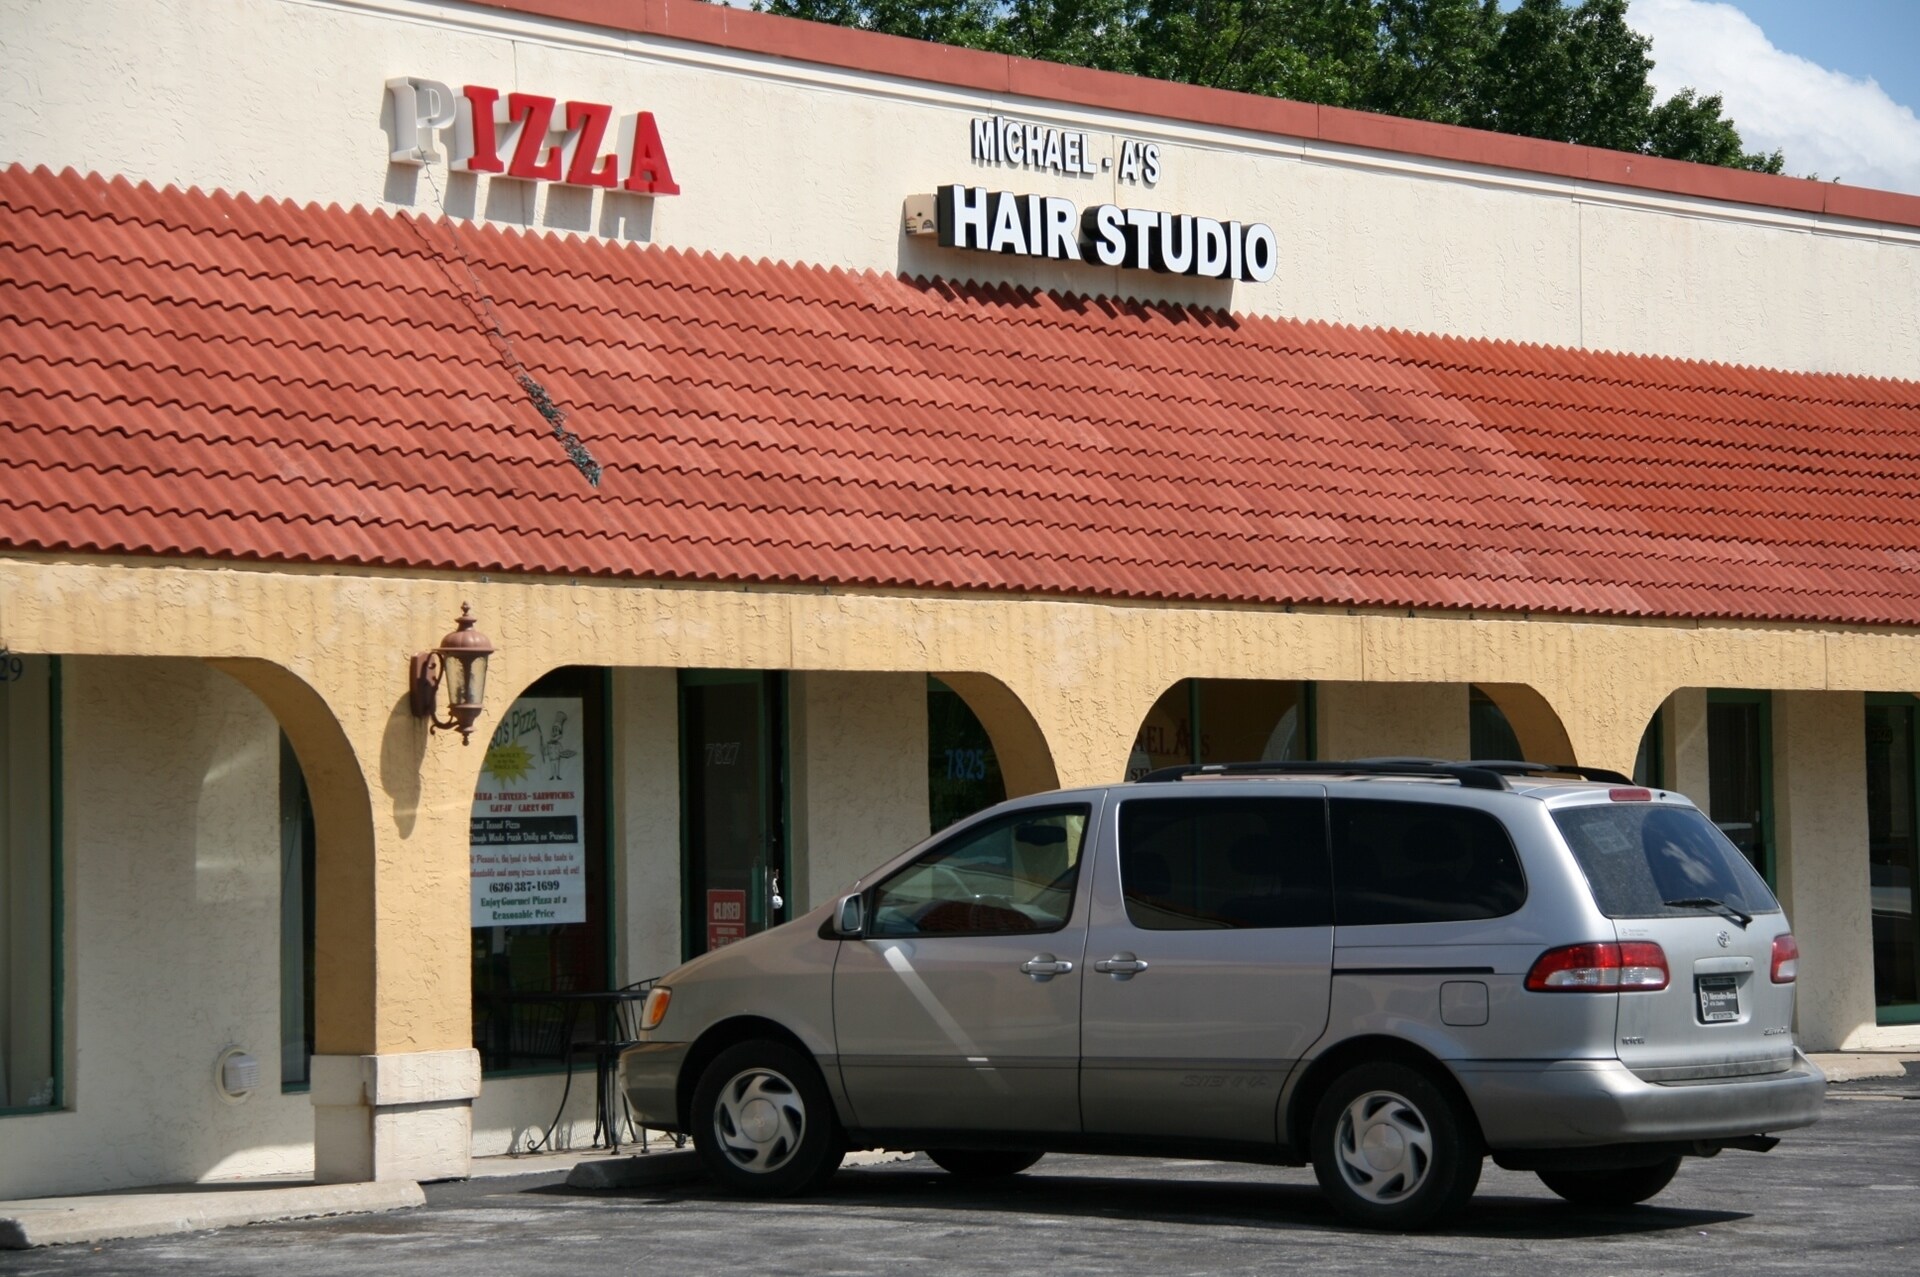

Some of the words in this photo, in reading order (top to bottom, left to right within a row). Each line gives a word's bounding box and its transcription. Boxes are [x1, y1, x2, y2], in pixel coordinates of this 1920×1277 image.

[385, 76, 680, 196] PIZZA
[971, 115, 1097, 174] MICHAEL
[1119, 140, 1162, 185] A'S
[950, 184, 1082, 261] HAIR
[1094, 203, 1278, 283] STUDIO
[944, 748, 986, 781] 7825
[532, 791, 575, 801] SANDWICHES
[489, 881, 513, 894] (636)
[514, 880, 560, 893] 387-1699
[480, 897, 500, 909] Enjoy
[532, 895, 551, 906] Pizza
[713, 902, 740, 920] CLOSED
[492, 910, 533, 921] Reasonable
[535, 909, 555, 919] Price
